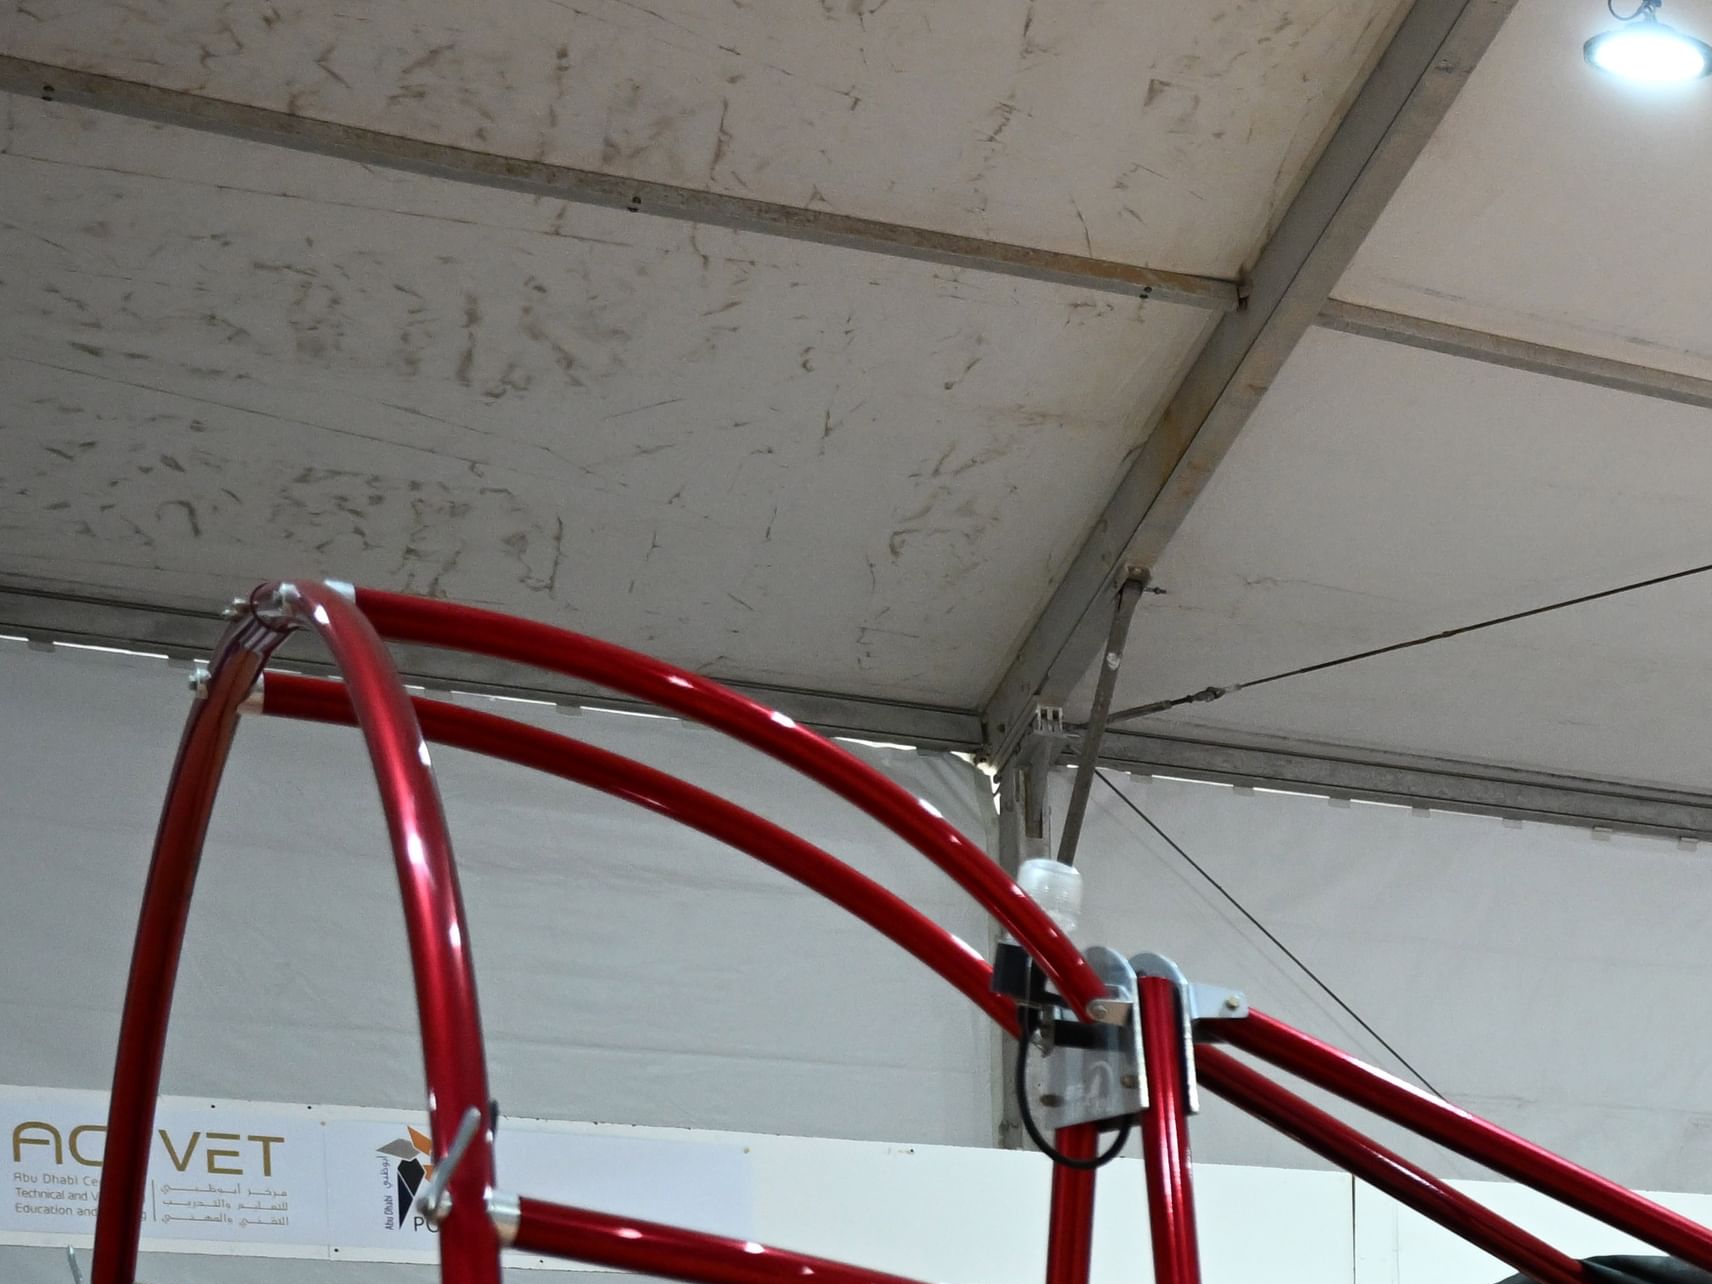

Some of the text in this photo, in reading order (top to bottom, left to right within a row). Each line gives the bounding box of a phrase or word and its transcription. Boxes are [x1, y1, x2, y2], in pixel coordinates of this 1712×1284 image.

[12, 1121, 285, 1177] ACVET
[14, 1172, 37, 1185] Abu
[43, 1173, 78, 1186] Dhabi
[15, 1188, 64, 1200] Technical
[68, 1190, 88, 1201] and
[15, 1203, 98, 1216] Education and
